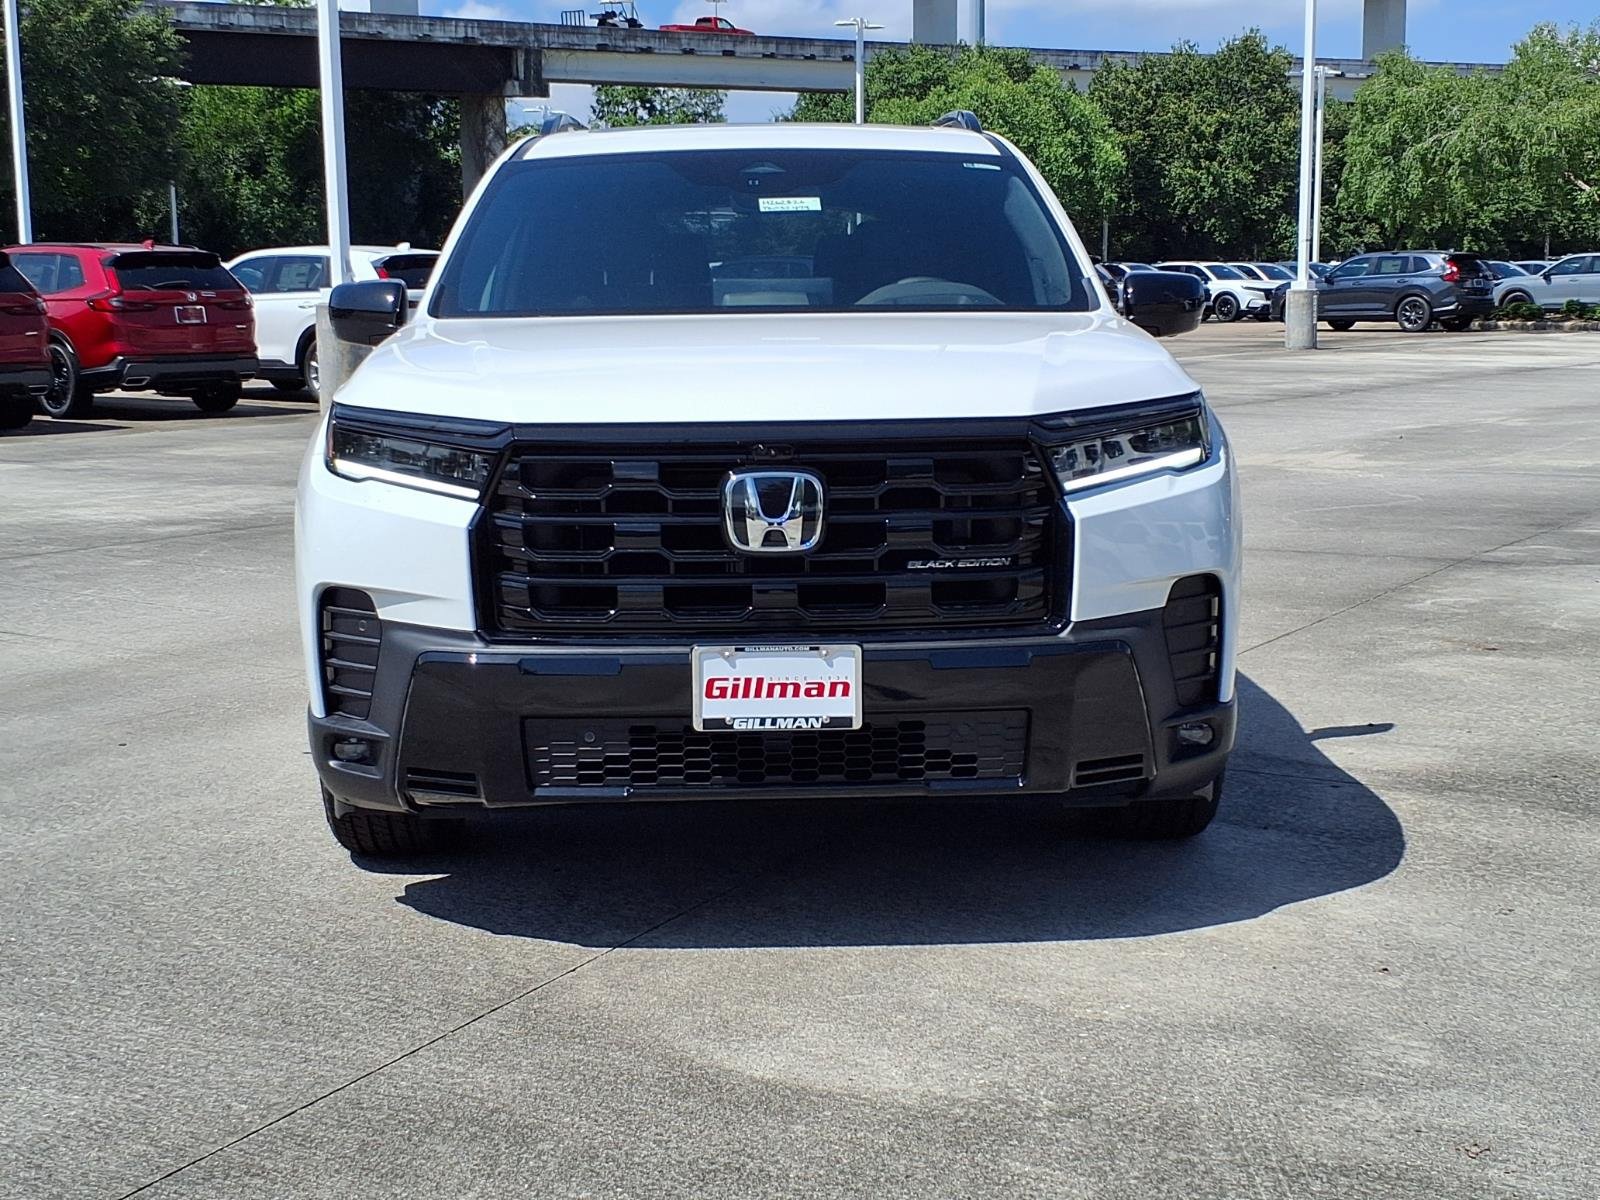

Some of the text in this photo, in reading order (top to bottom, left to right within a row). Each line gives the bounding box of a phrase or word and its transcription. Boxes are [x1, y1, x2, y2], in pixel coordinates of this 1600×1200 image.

[907, 557, 1011, 569] BLACK EDITION
[704, 677, 851, 699] Gillman
[733, 717, 822, 730] GILLMAN
